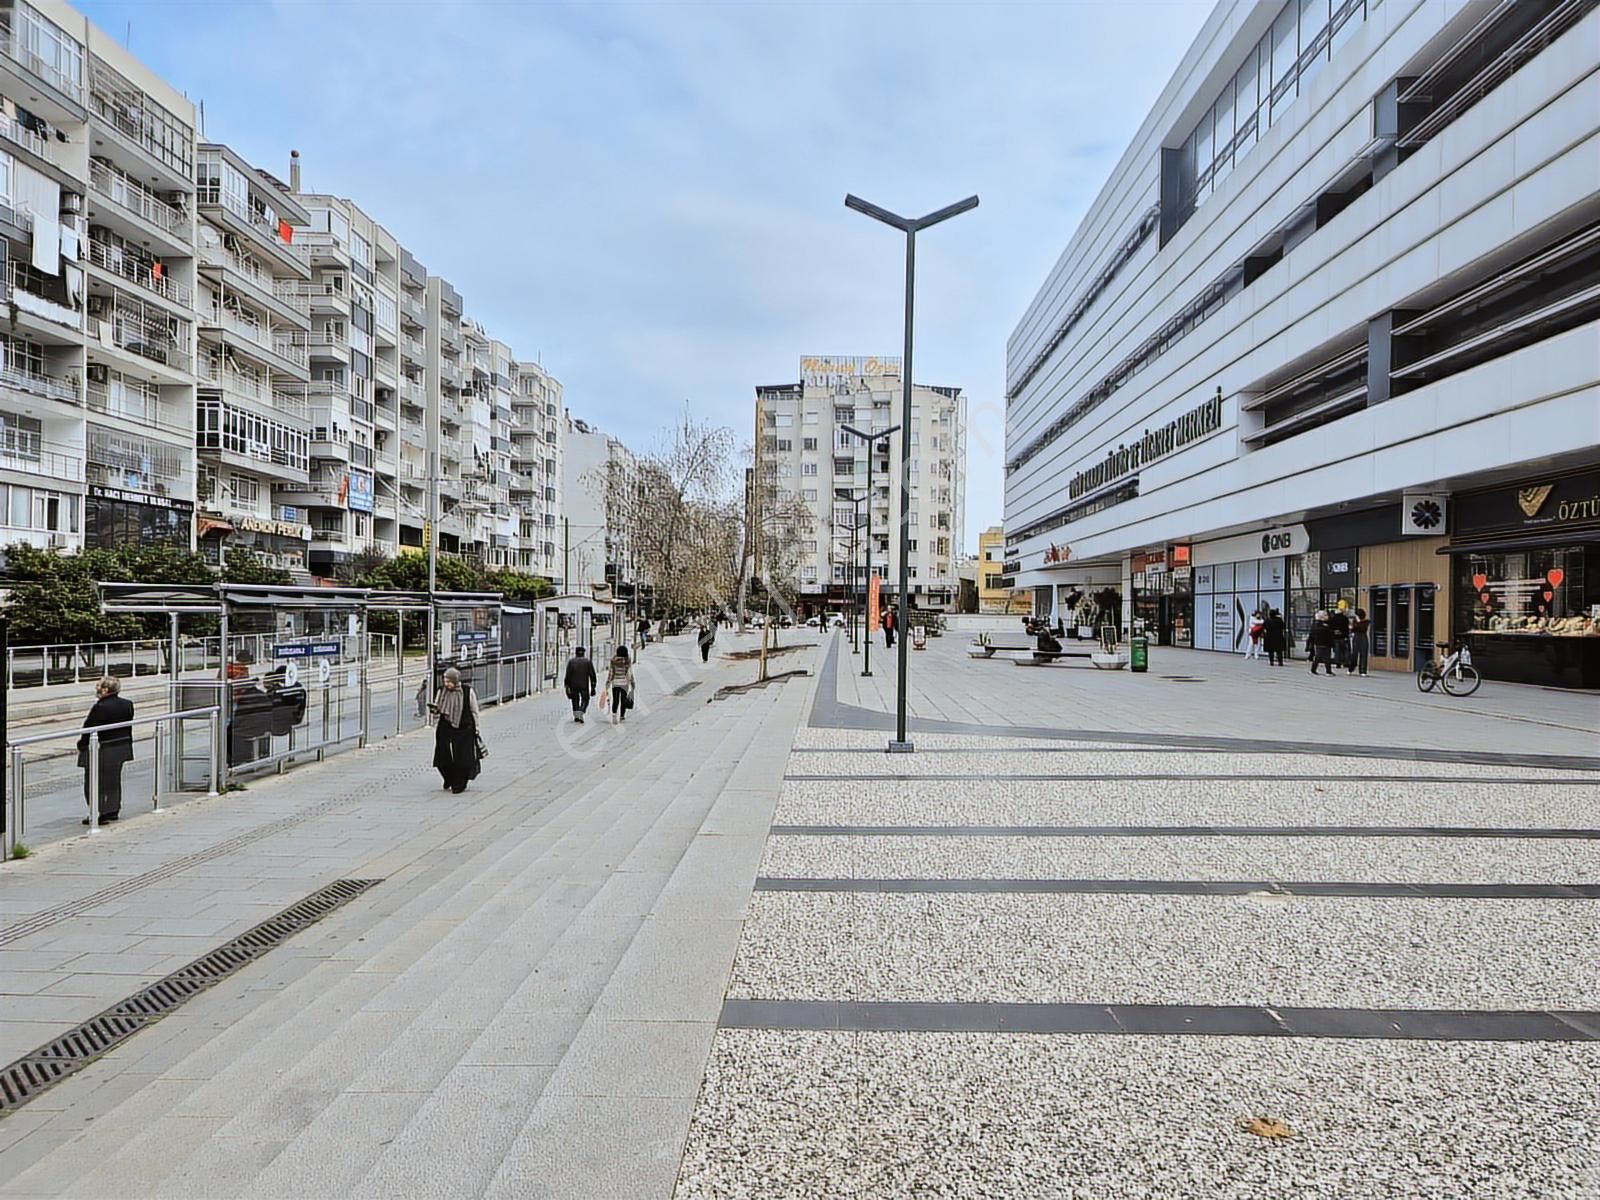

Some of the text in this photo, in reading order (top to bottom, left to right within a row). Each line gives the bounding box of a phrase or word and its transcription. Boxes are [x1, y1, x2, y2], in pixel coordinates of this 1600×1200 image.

[1176, 385, 1222, 447] MERKEZİ
[1558, 495, 1600, 521] ÖZTÜ
[1271, 532, 1291, 551] QNB
